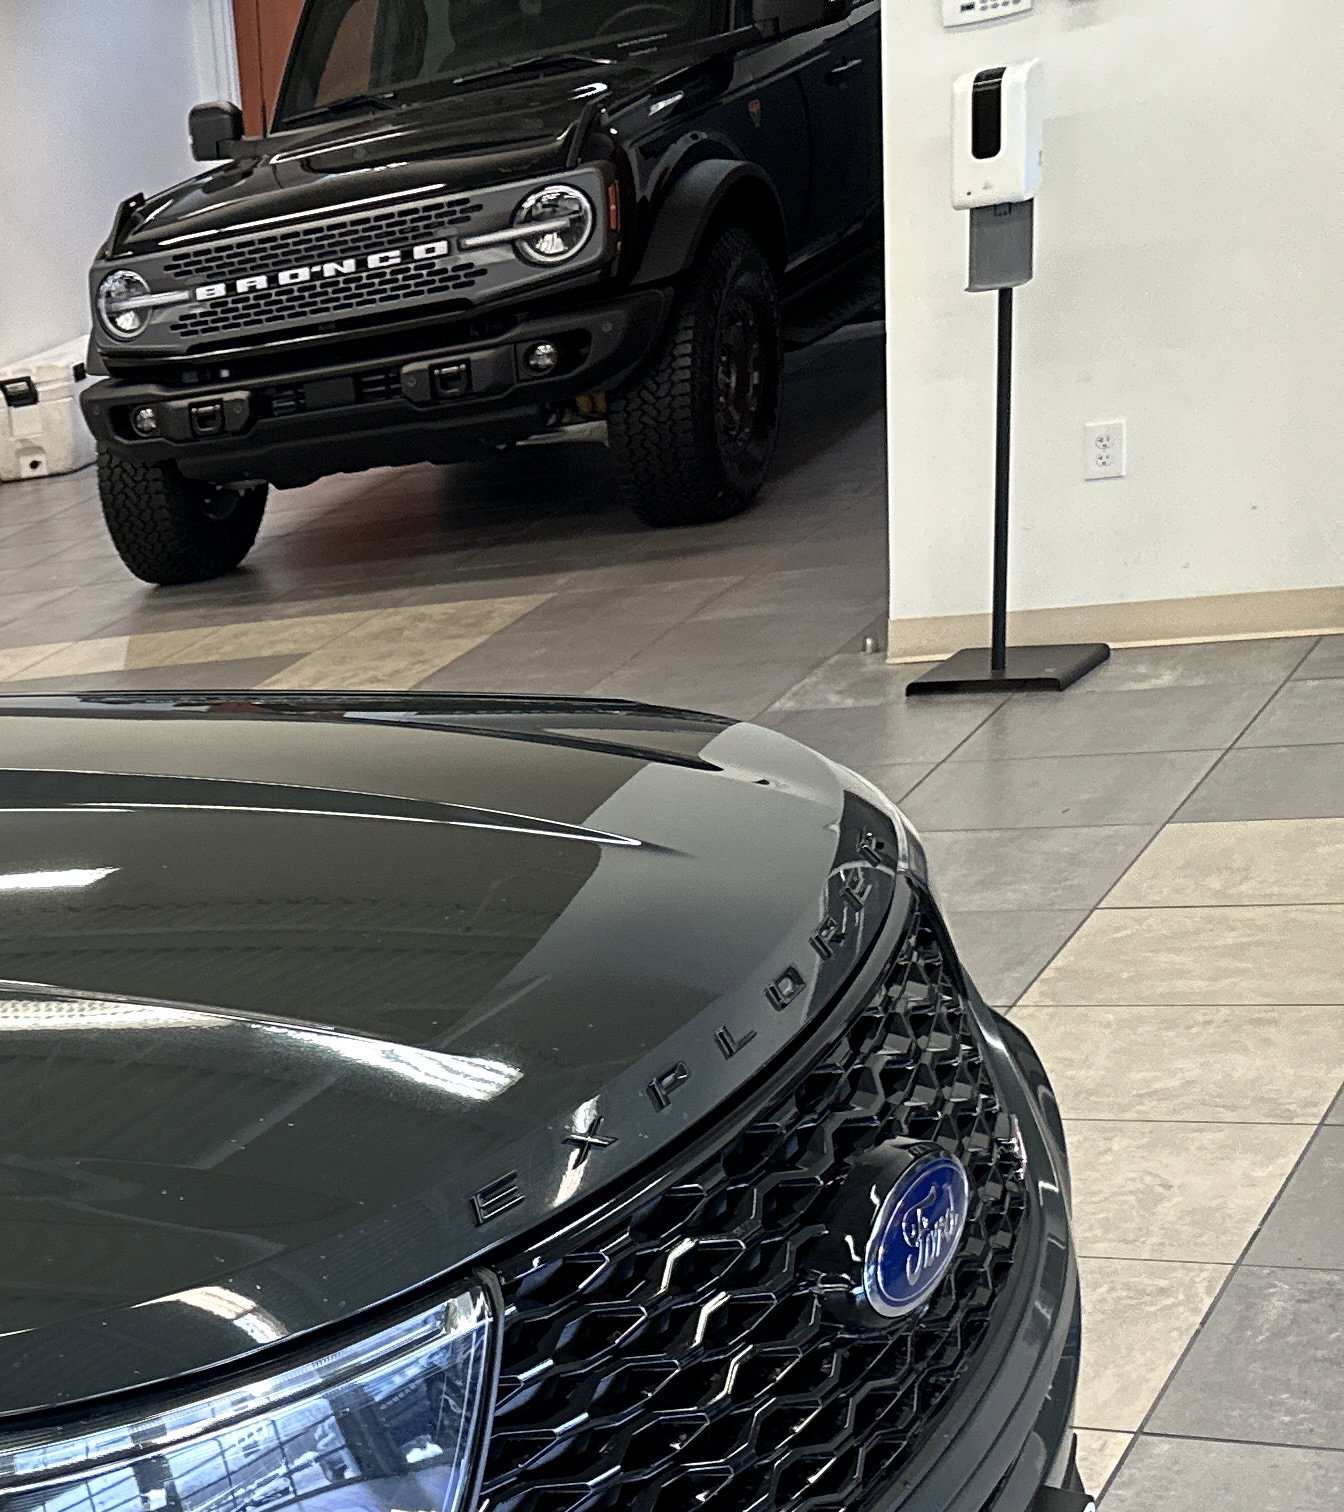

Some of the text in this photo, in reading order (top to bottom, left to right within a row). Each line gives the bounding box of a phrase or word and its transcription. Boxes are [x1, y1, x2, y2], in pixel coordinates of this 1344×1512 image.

[195, 239, 449, 301] BRONCO
[470, 829, 886, 1228] EXPLORER
[900, 1182, 961, 1287] Ford
